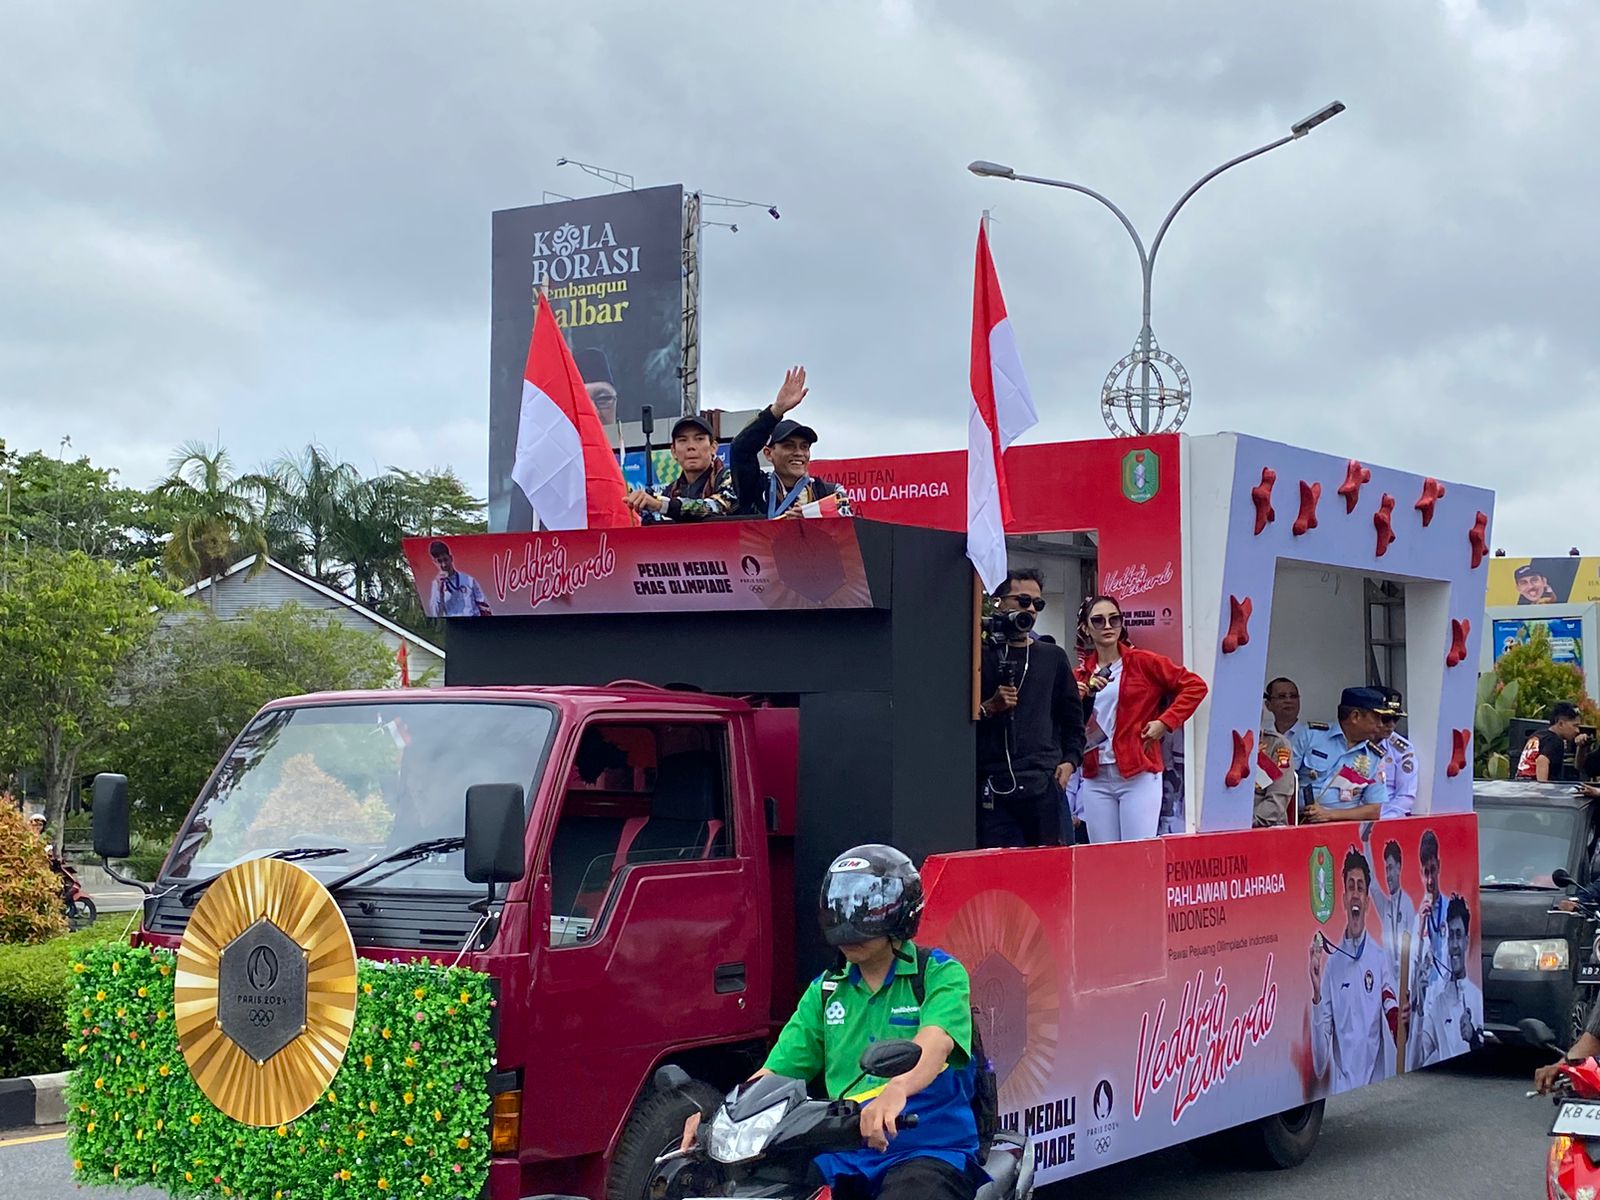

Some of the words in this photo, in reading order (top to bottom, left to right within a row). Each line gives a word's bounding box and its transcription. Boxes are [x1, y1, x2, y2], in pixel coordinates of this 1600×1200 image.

[532, 246, 641, 286] BORASI
[532, 298, 630, 329] albar
[819, 468, 895, 486] AMBUTAN
[846, 487, 867, 502] AN
[870, 481, 949, 502] OLAHRAGA
[529, 531, 616, 608] Leonardo
[636, 562, 682, 578] PERAIH
[682, 560, 729, 577] MEDALI
[633, 580, 667, 595] EMAS
[668, 578, 734, 595] OLIMPIADE
[838, 860, 861, 868] GM
[1166, 855, 1248, 882] PENYAMBUTAN
[1167, 881, 1228, 908] PAHLAWAN
[1230, 873, 1286, 900] OLAHRAGA
[1167, 905, 1227, 933] INDONESIA
[1189, 945, 1216, 957] Pejuang
[1217, 939, 1248, 953] Olimpiade
[1581, 966, 1593, 975] KB
[1593, 967, 1600, 975] 2
[237, 995, 262, 1005] PARIS
[263, 996, 287, 1005] 2024
[1171, 952, 1278, 1126] Leonardo
[1024, 1096, 1076, 1138] MEDALI
[1562, 1106, 1583, 1118] KB
[1034, 1132, 1076, 1172] PIADE
